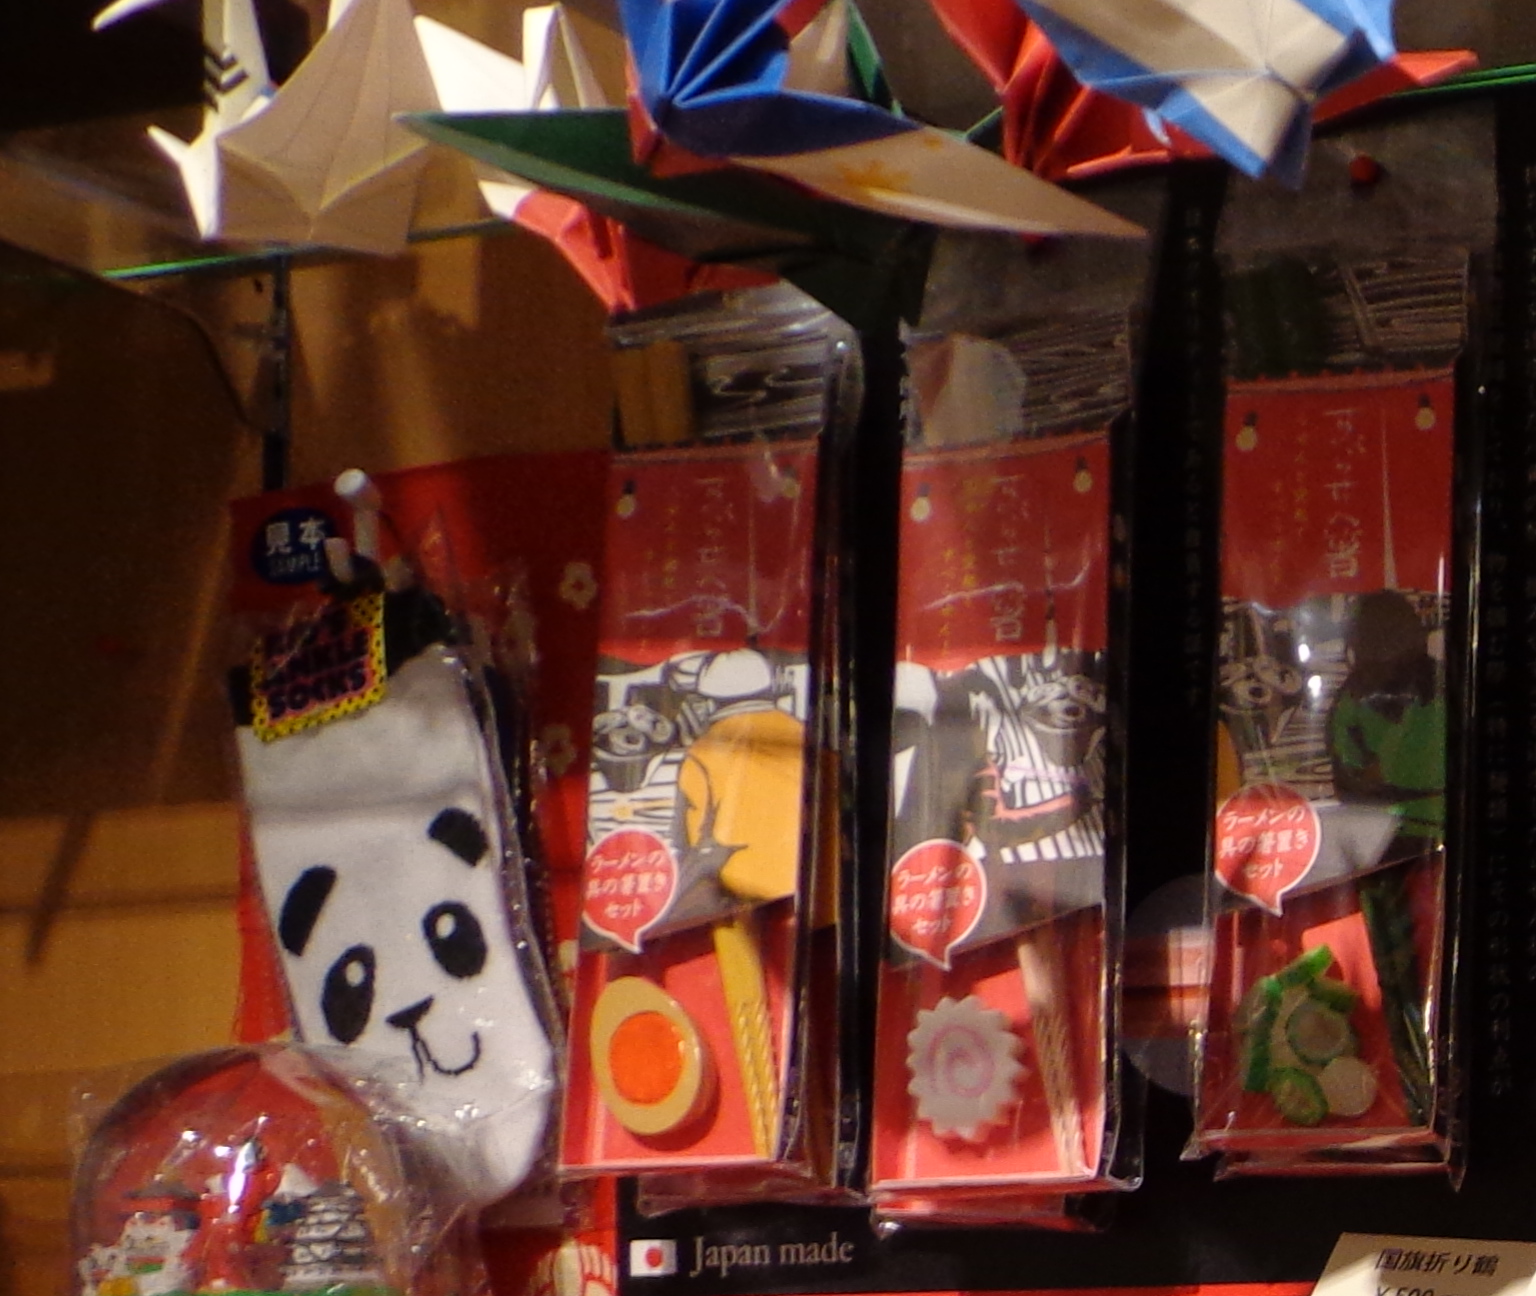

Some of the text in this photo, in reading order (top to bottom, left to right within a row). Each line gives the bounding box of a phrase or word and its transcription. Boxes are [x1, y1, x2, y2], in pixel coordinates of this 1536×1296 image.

[266, 517, 326, 555] 見本
[690, 1231, 855, 1278] Japan made
[1375, 1248, 1499, 1277] 国旗折り鶴
